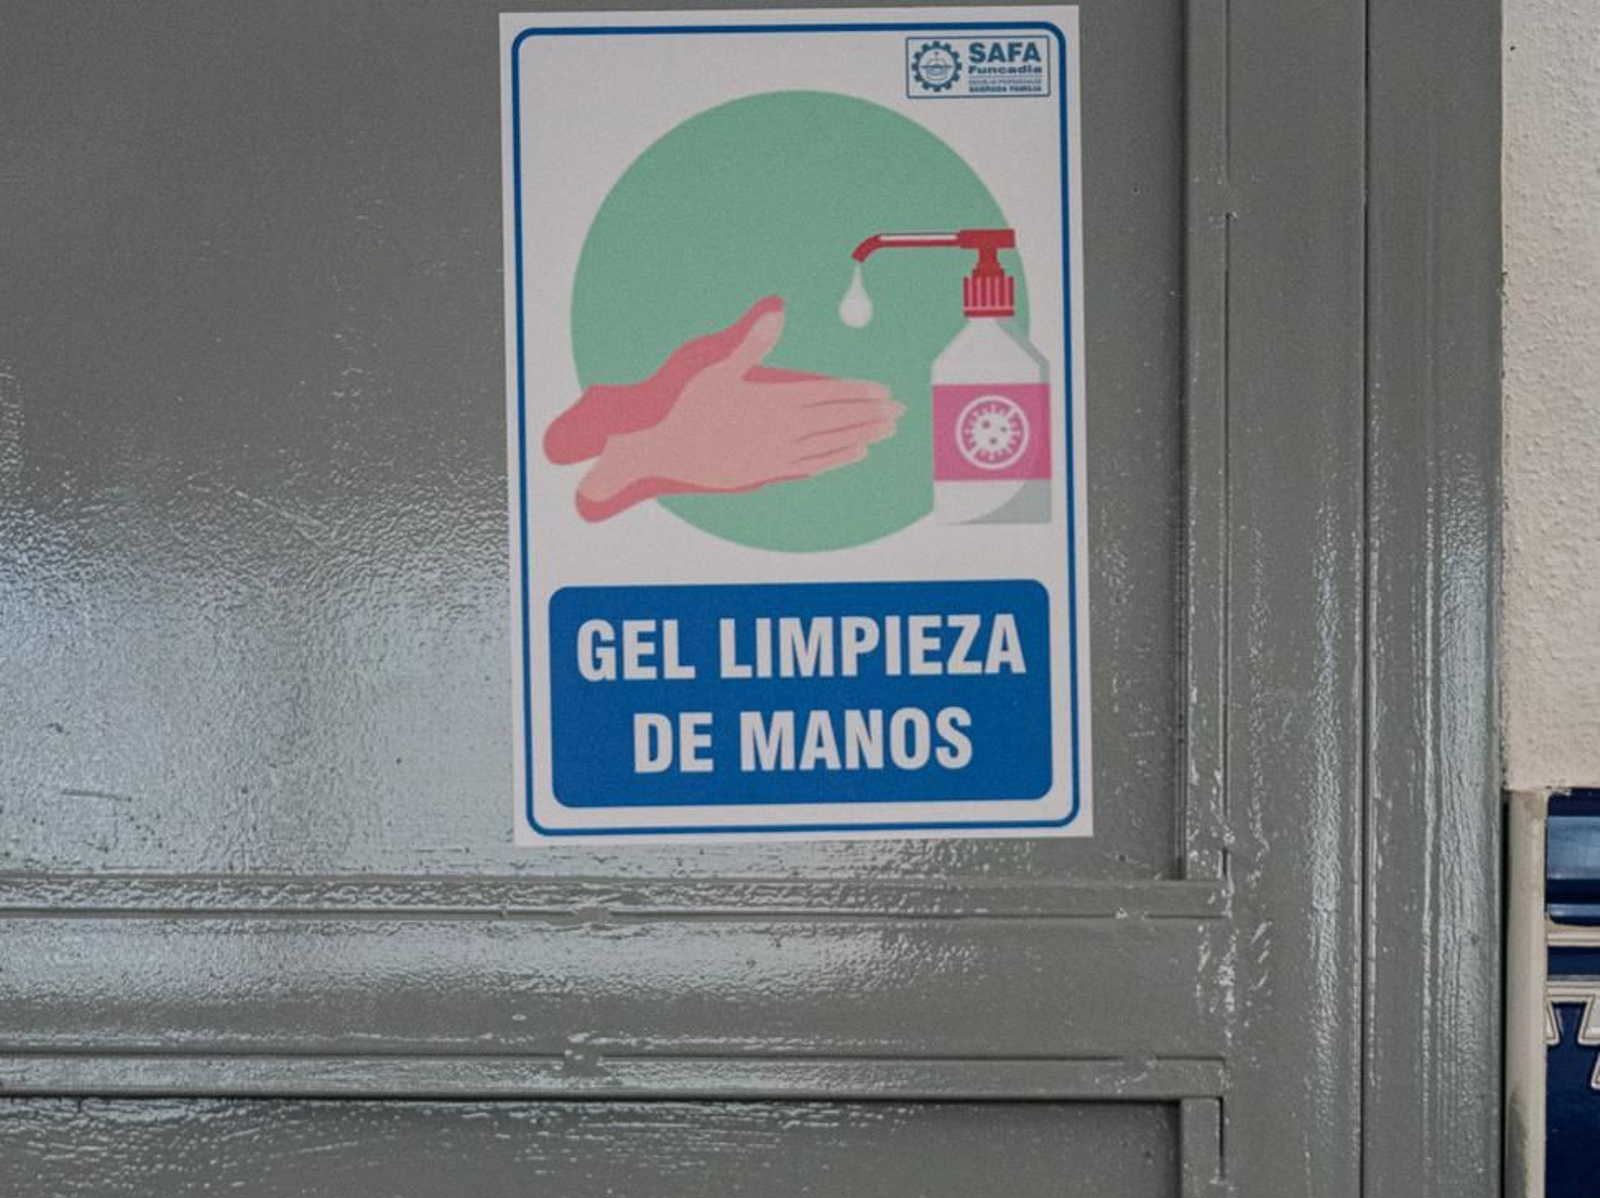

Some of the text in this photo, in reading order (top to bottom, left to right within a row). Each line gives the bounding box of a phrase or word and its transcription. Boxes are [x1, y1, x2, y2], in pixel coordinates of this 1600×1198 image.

[968, 42, 1042, 63] SAFA
[576, 613, 1027, 683] GEL LIMPIEZA
[633, 705, 974, 774] DE MANOS
